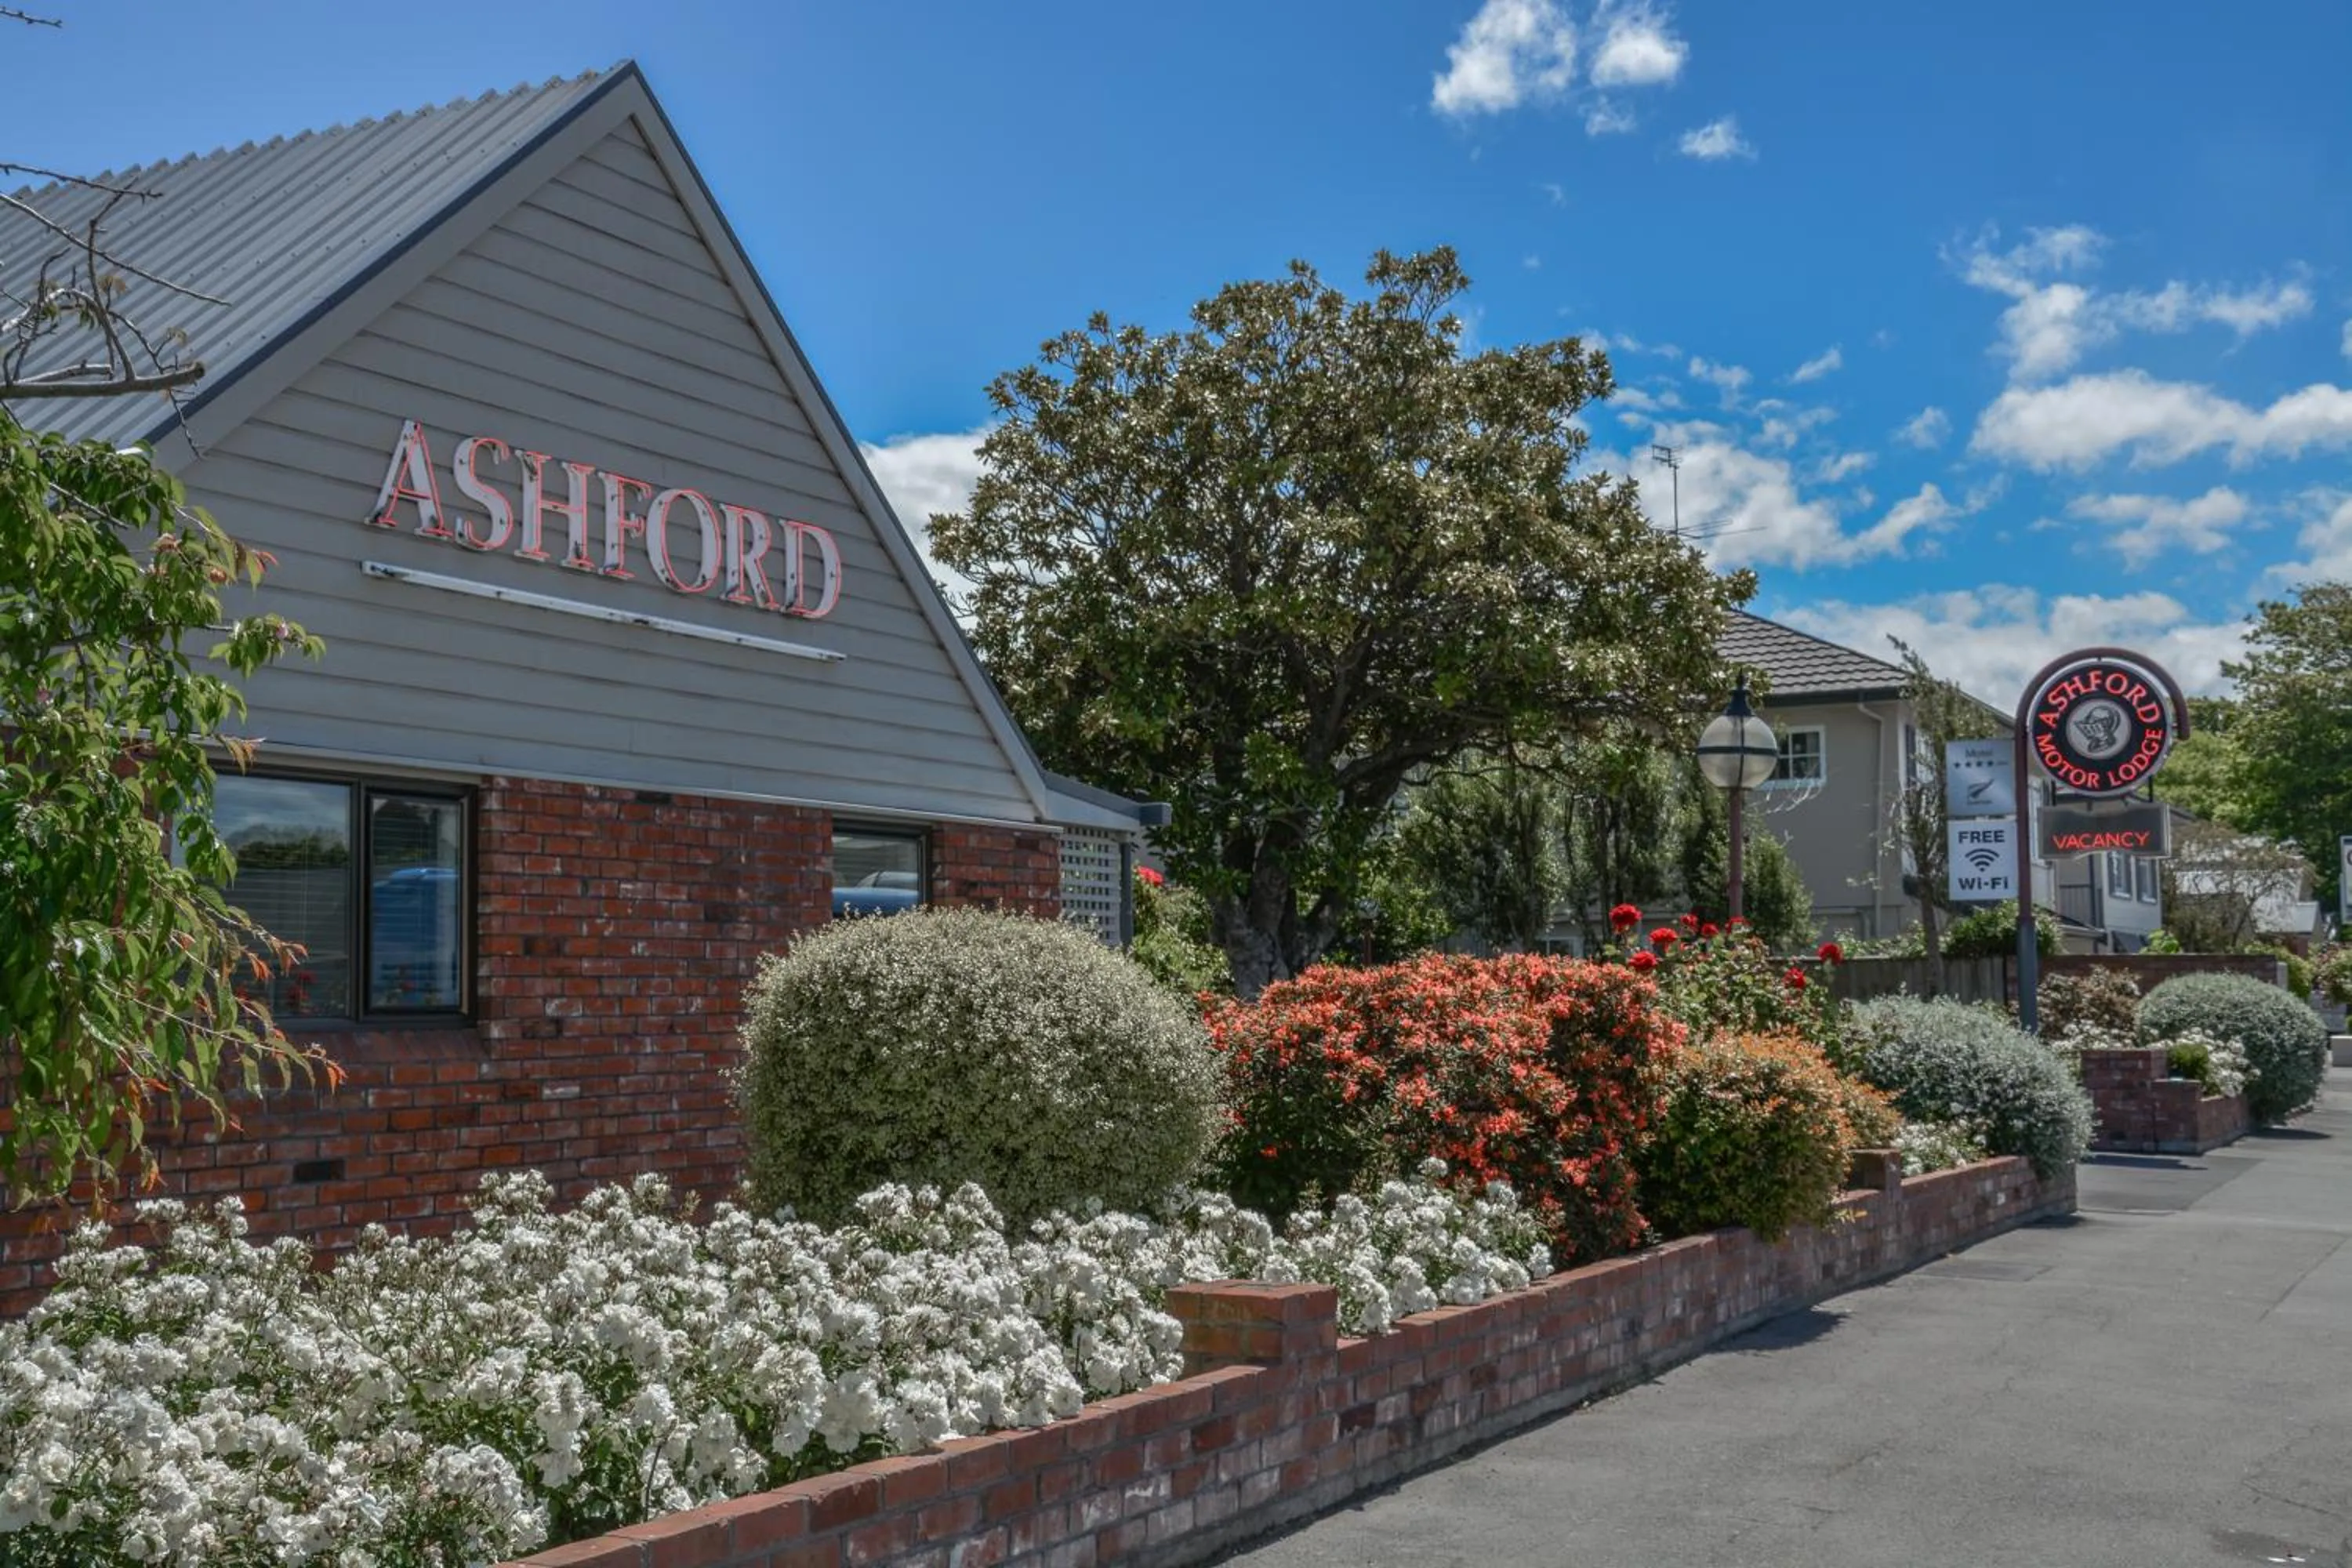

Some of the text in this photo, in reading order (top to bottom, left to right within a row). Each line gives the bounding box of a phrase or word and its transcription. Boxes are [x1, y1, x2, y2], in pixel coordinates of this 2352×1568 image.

[364, 419, 842, 619] ASHFORD
[2038, 670, 2161, 730] ASHFORD
[2036, 728, 2164, 788] MOTOR LODGE
[1958, 829, 2005, 844] FREE
[2052, 830, 2151, 850] VACANCY
